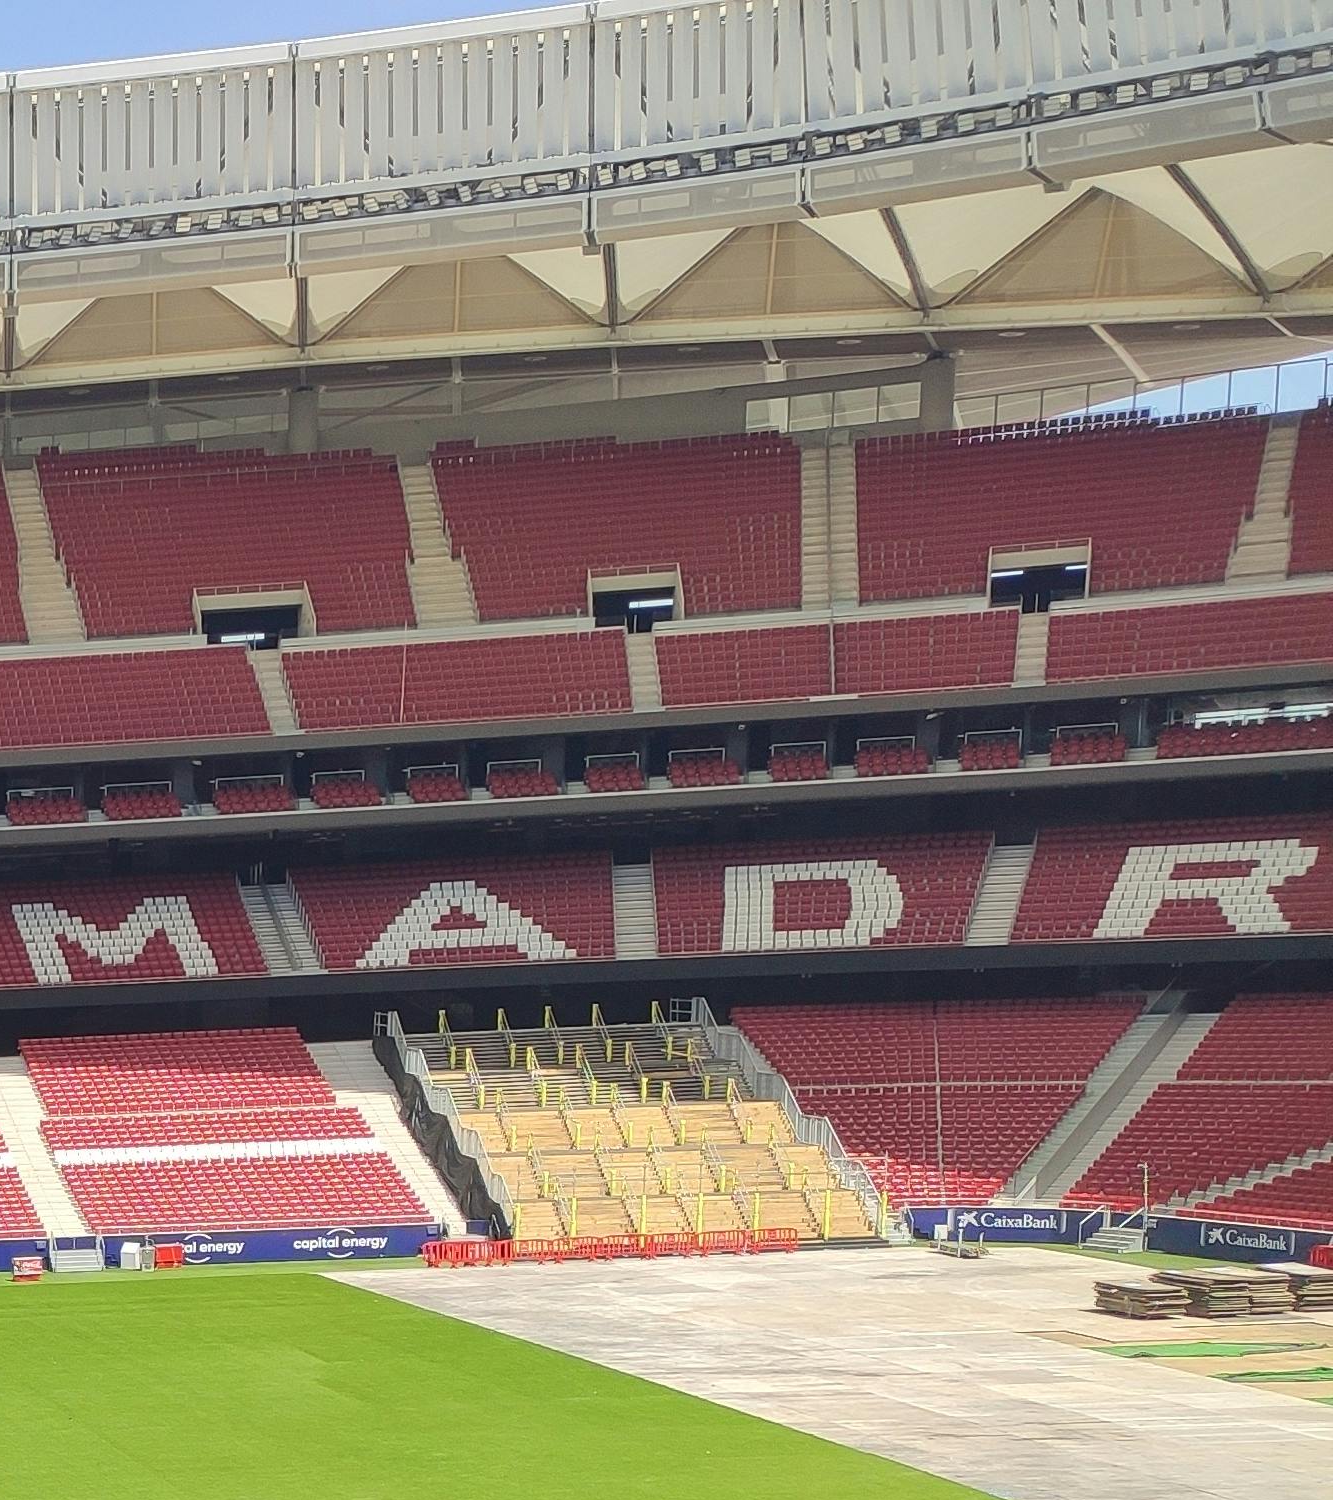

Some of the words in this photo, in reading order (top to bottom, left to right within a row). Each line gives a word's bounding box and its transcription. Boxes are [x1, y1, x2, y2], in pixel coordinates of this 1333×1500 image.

[981, 1212, 1057, 1229] CaixaBank
[199, 1242, 245, 1254] energy
[293, 1236, 339, 1251] capital
[342, 1237, 388, 1249] energy
[1225, 1229, 1287, 1251] CaixaBank
